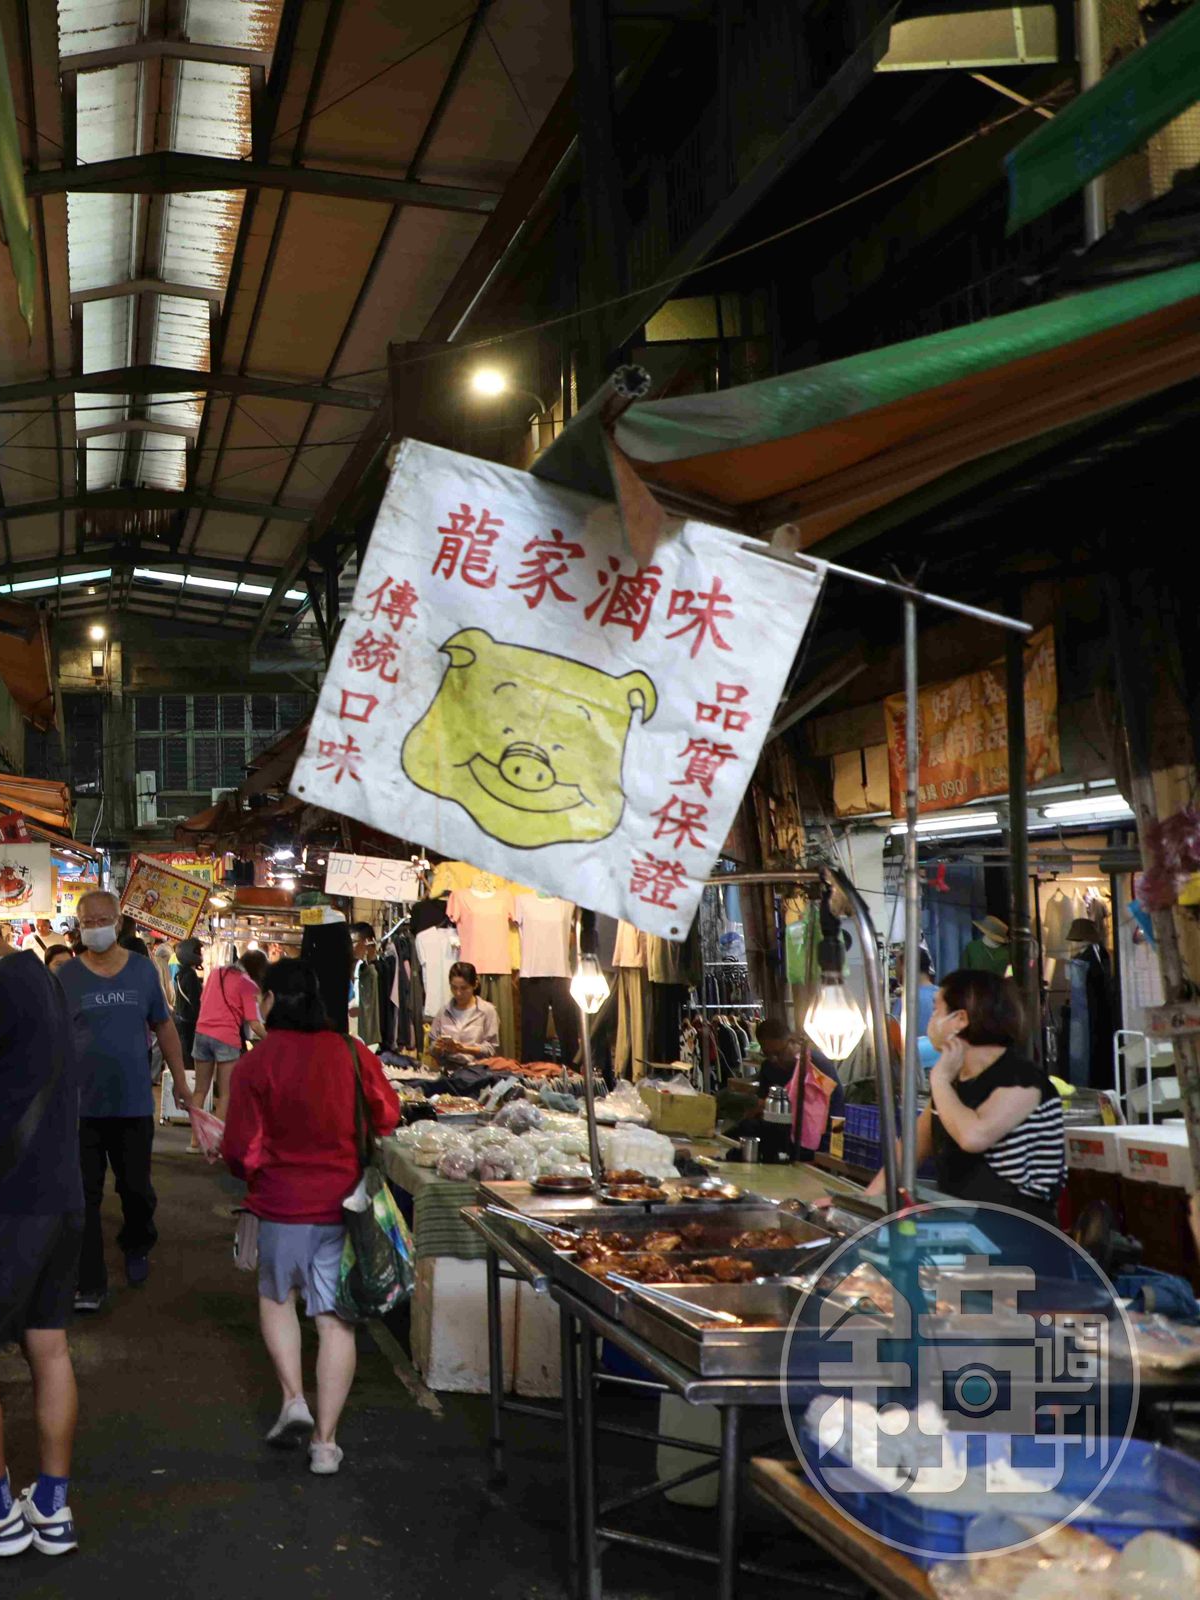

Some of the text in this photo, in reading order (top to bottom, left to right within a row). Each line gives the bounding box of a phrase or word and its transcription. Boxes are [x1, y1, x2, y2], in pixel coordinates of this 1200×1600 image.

[315, 573, 419, 786] 傳統口味
[431, 503, 734, 659] 龍家滷味
[628, 681, 752, 911] 品質保證
